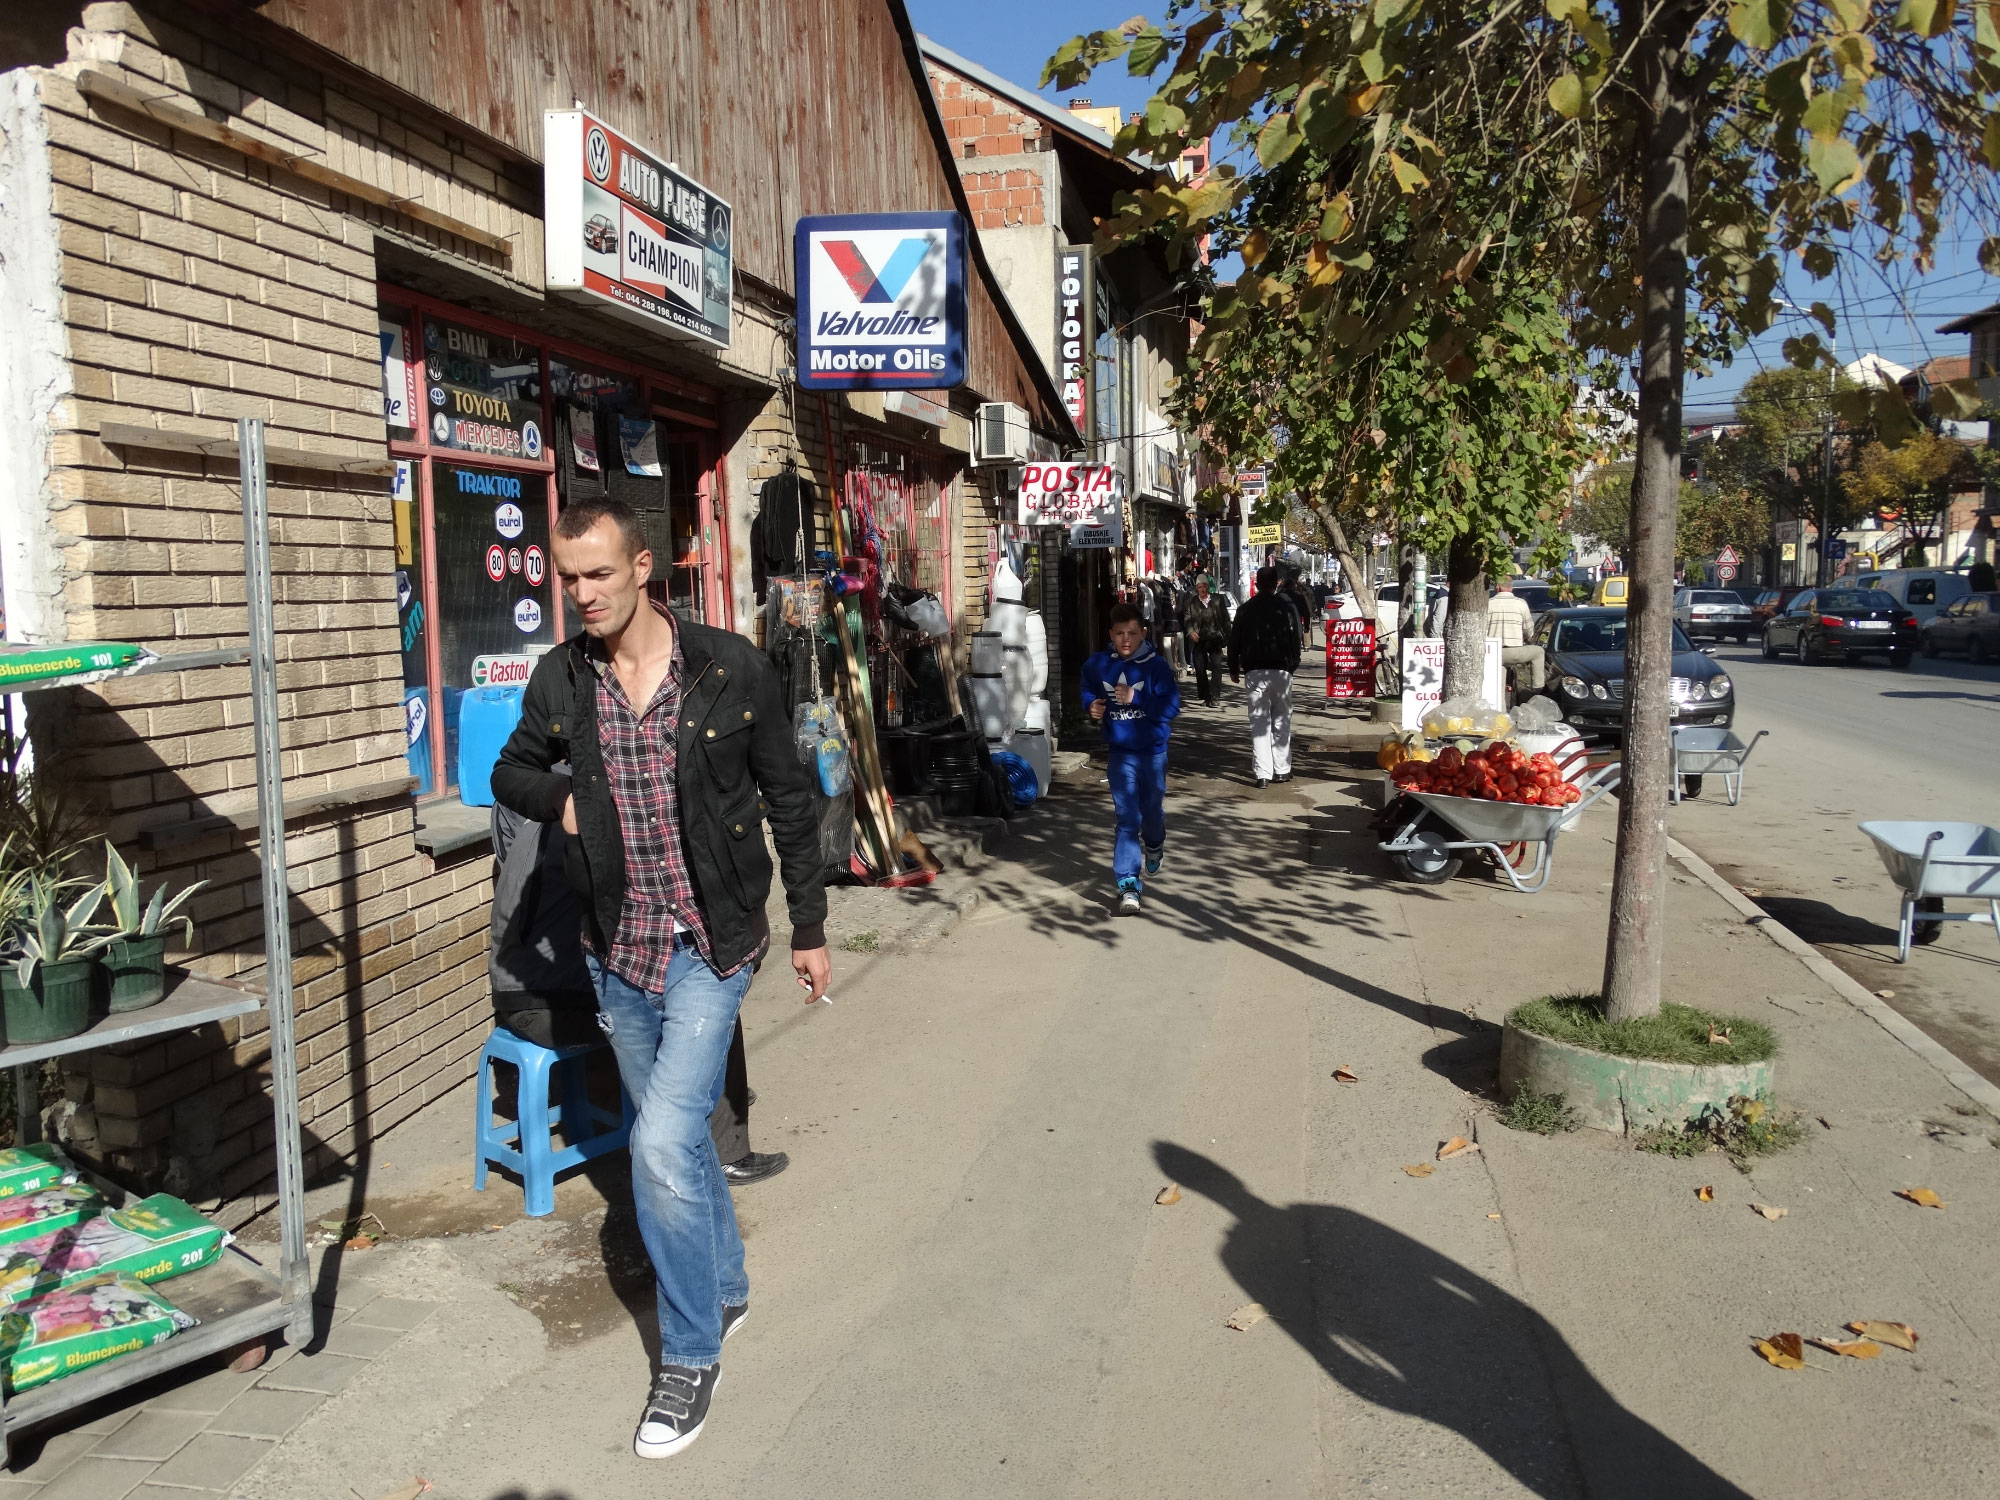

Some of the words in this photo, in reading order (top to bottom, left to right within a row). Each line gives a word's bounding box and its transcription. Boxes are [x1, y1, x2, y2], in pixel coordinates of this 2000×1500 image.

[619, 150, 660, 210] AUTO
[663, 175, 706, 238] PJESË
[628, 230, 700, 293] CHAMPION
[609, 285, 625, 299] Tel:
[626, 292, 641, 305] 044
[642, 297, 656, 312] 288
[657, 305, 672, 320] 196,
[673, 312, 687, 326] 044
[687, 317, 700, 330] 214
[700, 322, 712, 335] 052
[816, 310, 940, 336] Valvoline
[447, 327, 489, 359] BMW
[810, 349, 886, 370] Motor
[893, 348, 946, 370] Oils
[452, 390, 512, 423] TOYOTA
[455, 419, 521, 453] MERCEDES
[455, 470, 521, 499] TRAKTOR
[1021, 465, 1112, 492] POSTA
[1025, 493, 1110, 511] GLOBAL
[1041, 510, 1094, 520] PHONE
[491, 555, 502, 571] 80
[511, 554, 520, 567] 70
[528, 556, 542, 575] 70
[1721, 568, 1732, 576] 30
[1333, 620, 1365, 632] FOTO
[1331, 633, 1372, 645] CANON
[0, 656, 82, 677] Blumenerde
[490, 659, 530, 682] Castrol
[65, 1337, 144, 1368] Blumenerde
